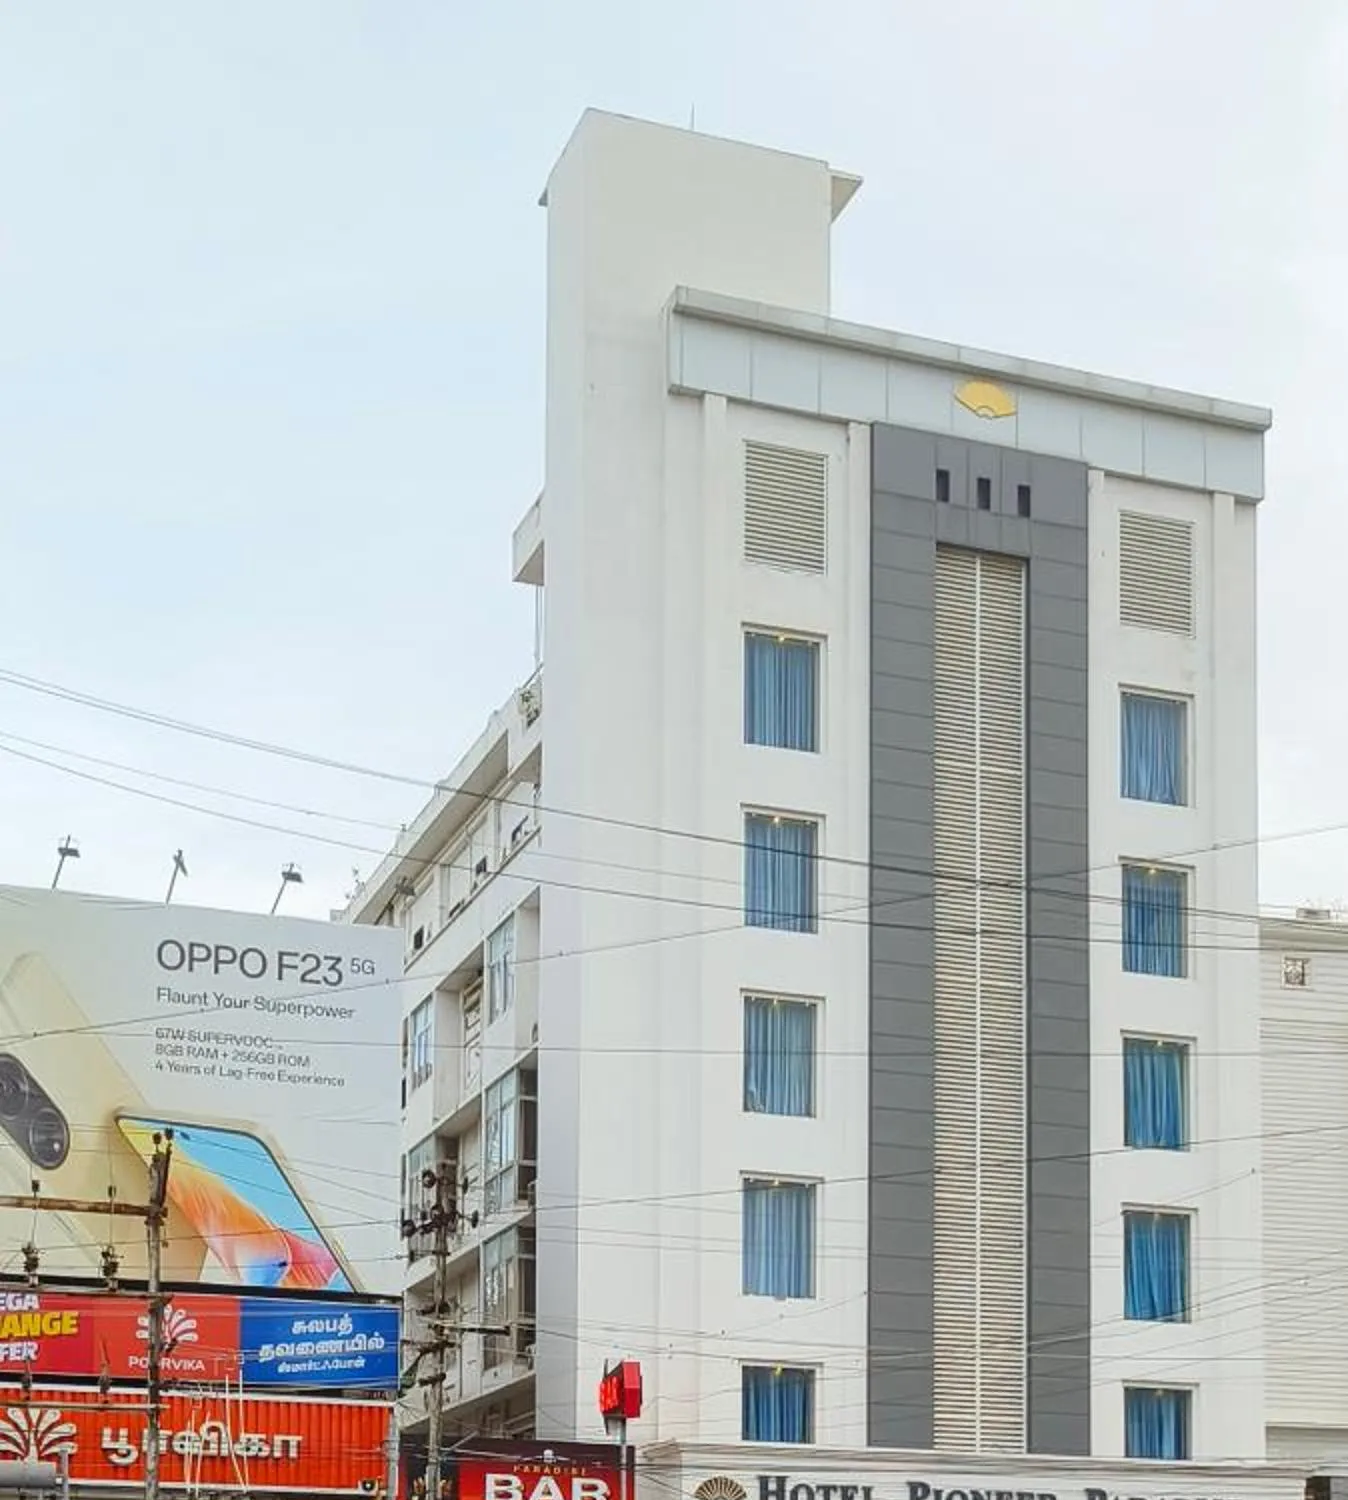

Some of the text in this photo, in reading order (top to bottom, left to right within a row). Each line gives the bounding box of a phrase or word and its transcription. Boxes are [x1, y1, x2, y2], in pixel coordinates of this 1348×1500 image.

[156, 939, 376, 987] OPPO F23 5G
[156, 986, 356, 1019] Flaunt Your Superpower
[155, 1027, 185, 1041] 67W
[155, 1043, 185, 1057] 8GB
[186, 1045, 219, 1060] RAM
[277, 1054, 311, 1068] ROM
[167, 1060, 201, 1075] Years
[203, 1063, 216, 1076] of
[277, 1069, 345, 1087] Experience
[128, 1355, 205, 1372] PORVIKA
